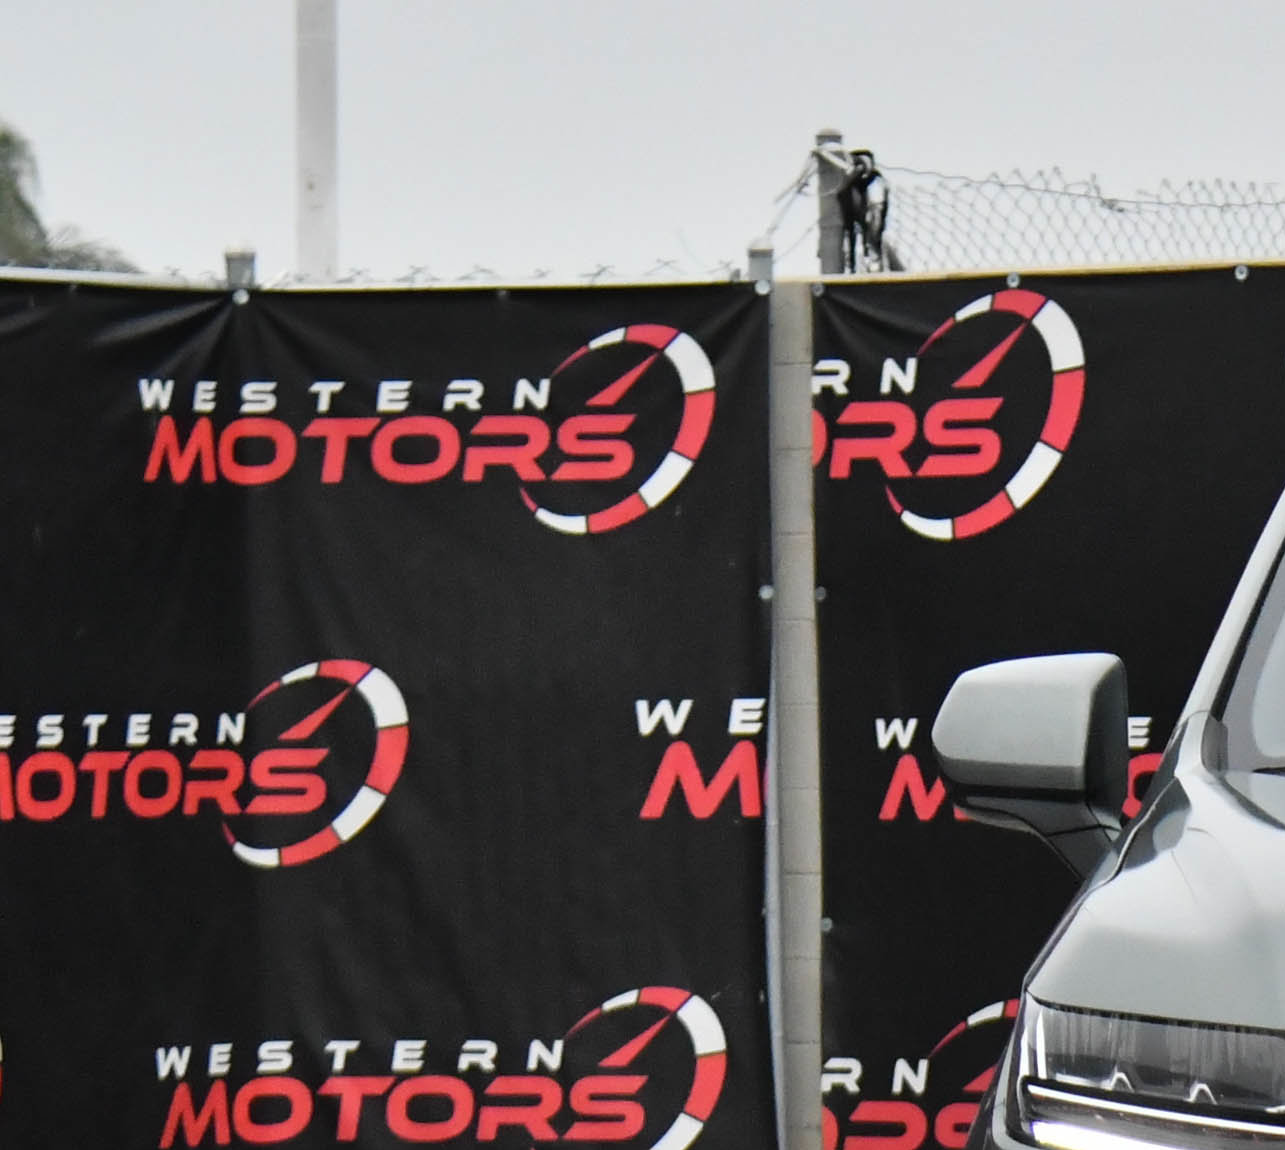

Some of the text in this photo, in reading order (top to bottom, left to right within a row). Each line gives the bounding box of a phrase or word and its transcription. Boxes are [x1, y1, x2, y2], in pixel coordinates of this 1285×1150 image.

[139, 378, 551, 413] WESTERN
[143, 414, 637, 485] MOTORS
[0, 749, 330, 821] OTORS
[156, 1038, 564, 1080] WESTERN
[159, 1076, 649, 1150] MOTORS
